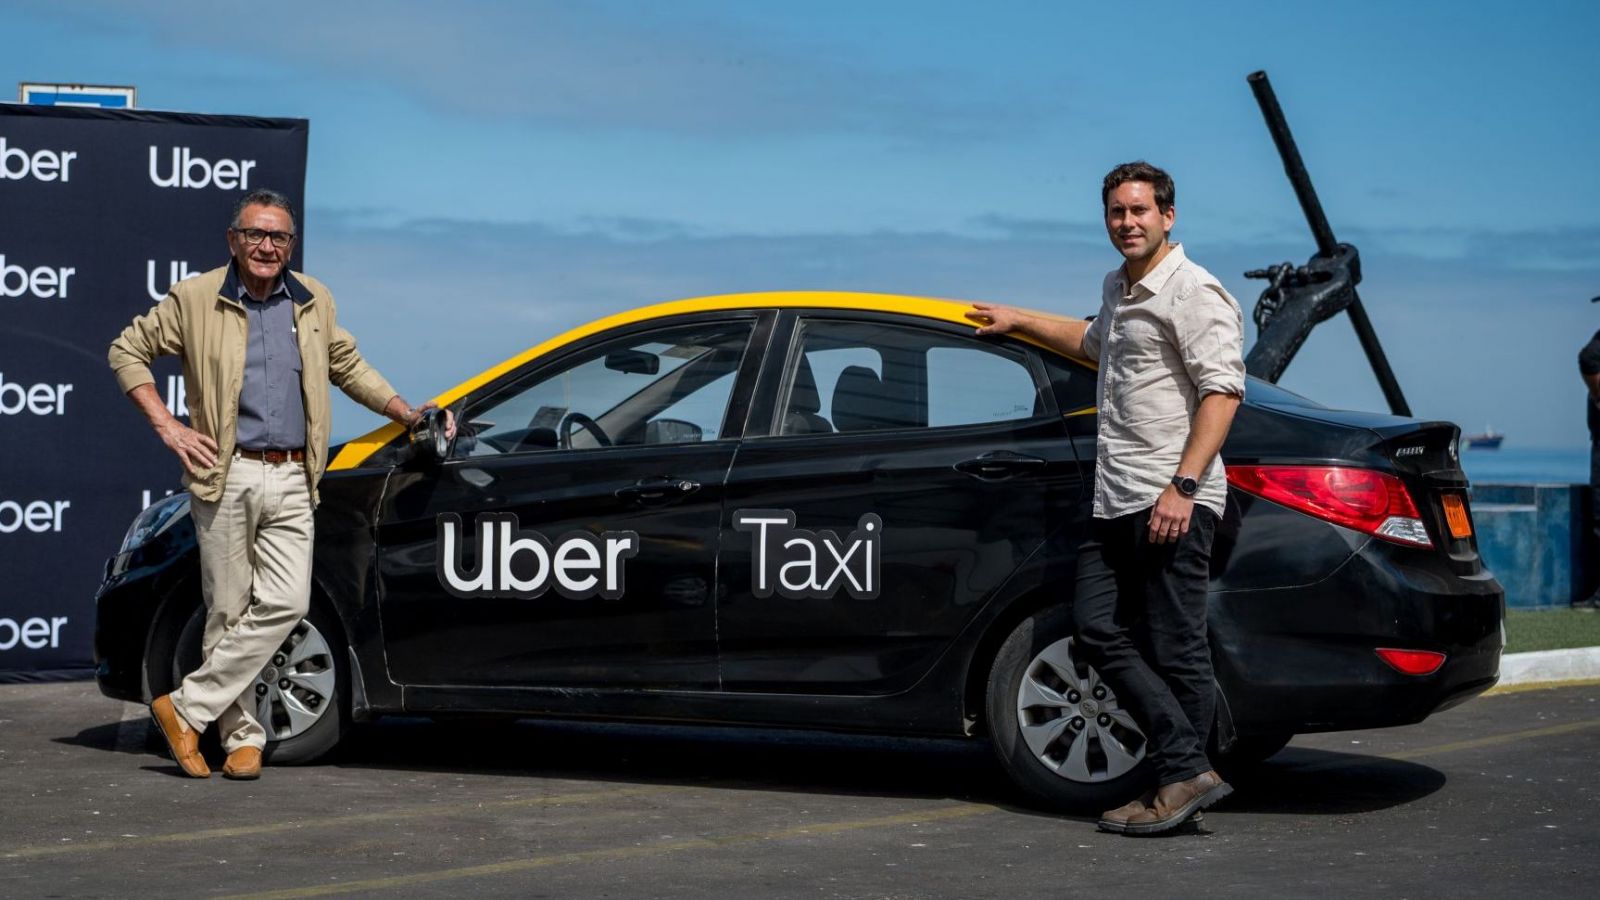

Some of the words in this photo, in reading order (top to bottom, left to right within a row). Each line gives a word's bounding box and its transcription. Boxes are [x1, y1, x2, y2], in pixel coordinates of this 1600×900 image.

[0, 137, 77, 182] ber
[149, 145, 256, 190] Uber
[0, 254, 76, 299] ber
[0, 372, 73, 416] ber
[0, 500, 71, 533] ber
[443, 521, 631, 592] Uber
[740, 517, 875, 592] Taxi
